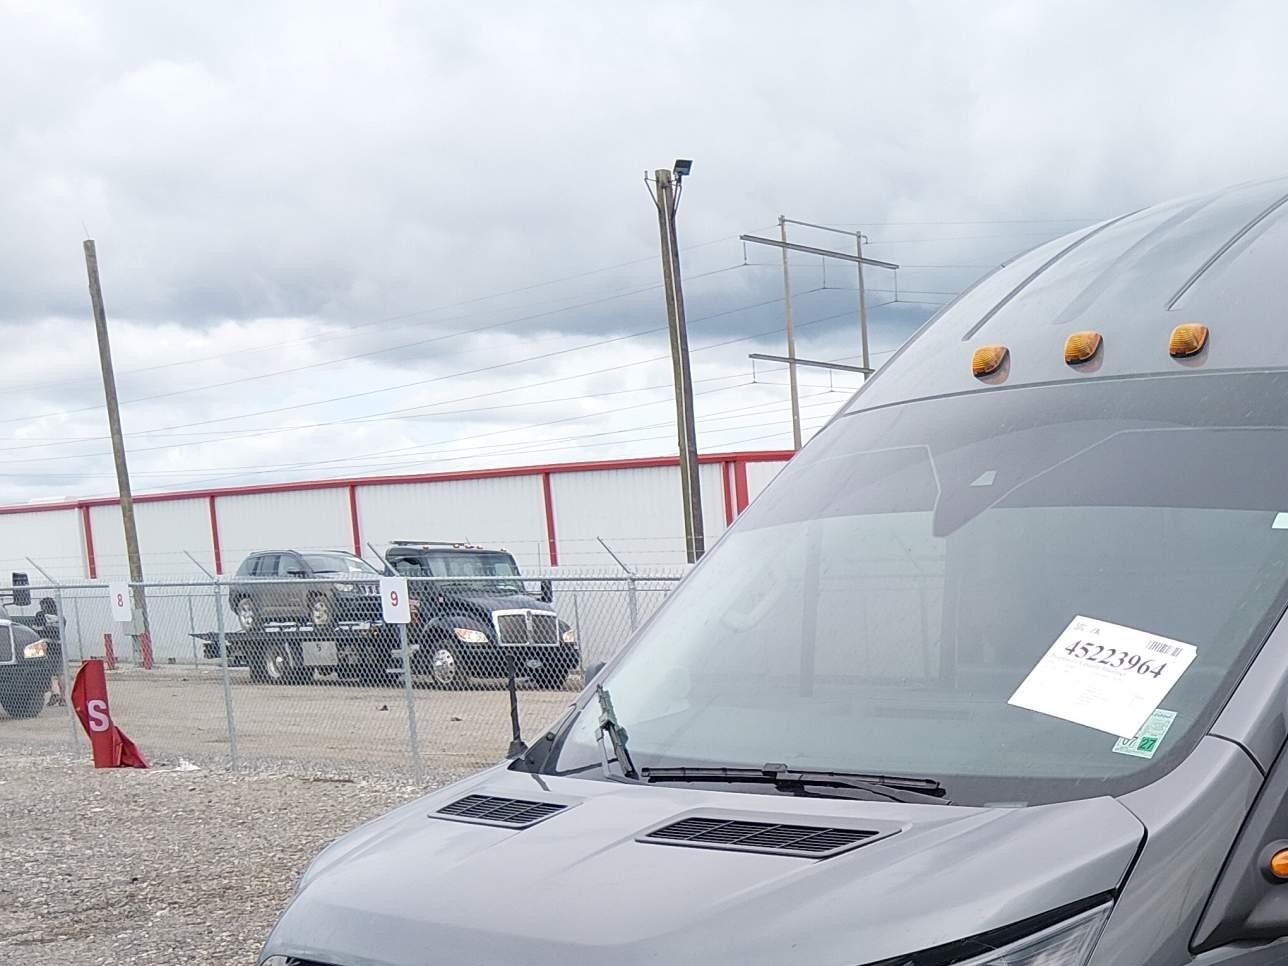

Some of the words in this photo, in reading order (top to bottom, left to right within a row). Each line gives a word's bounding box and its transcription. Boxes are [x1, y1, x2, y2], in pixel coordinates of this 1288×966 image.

[117, 593, 124, 607] 8
[390, 590, 399, 607] 9
[1064, 639, 1167, 679] 45223964
[87, 699, 110, 732] S
[1139, 738, 1157, 750] 27
